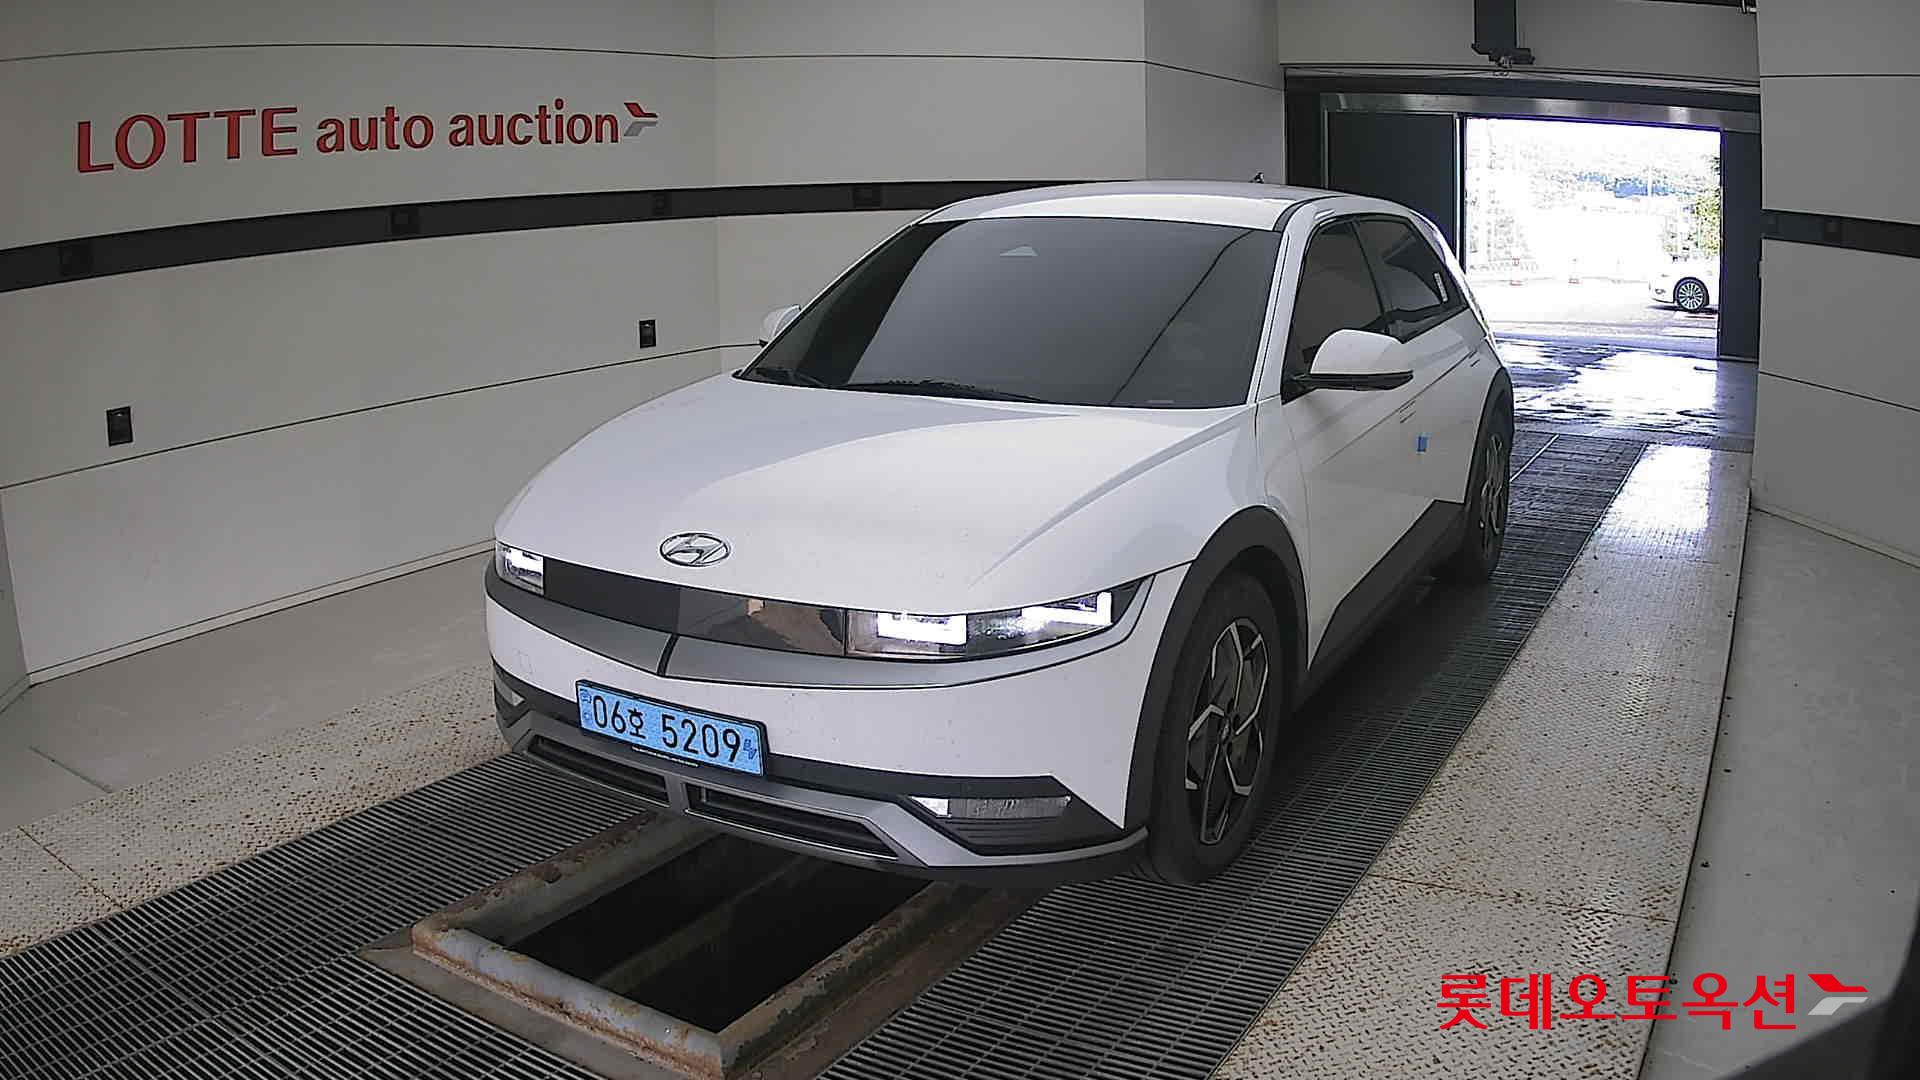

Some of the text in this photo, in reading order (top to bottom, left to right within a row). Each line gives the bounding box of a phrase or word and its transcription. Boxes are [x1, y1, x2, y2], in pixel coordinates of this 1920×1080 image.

[77, 98, 620, 173] LOTTE auto auction
[592, 695, 741, 762] 06호 5209
